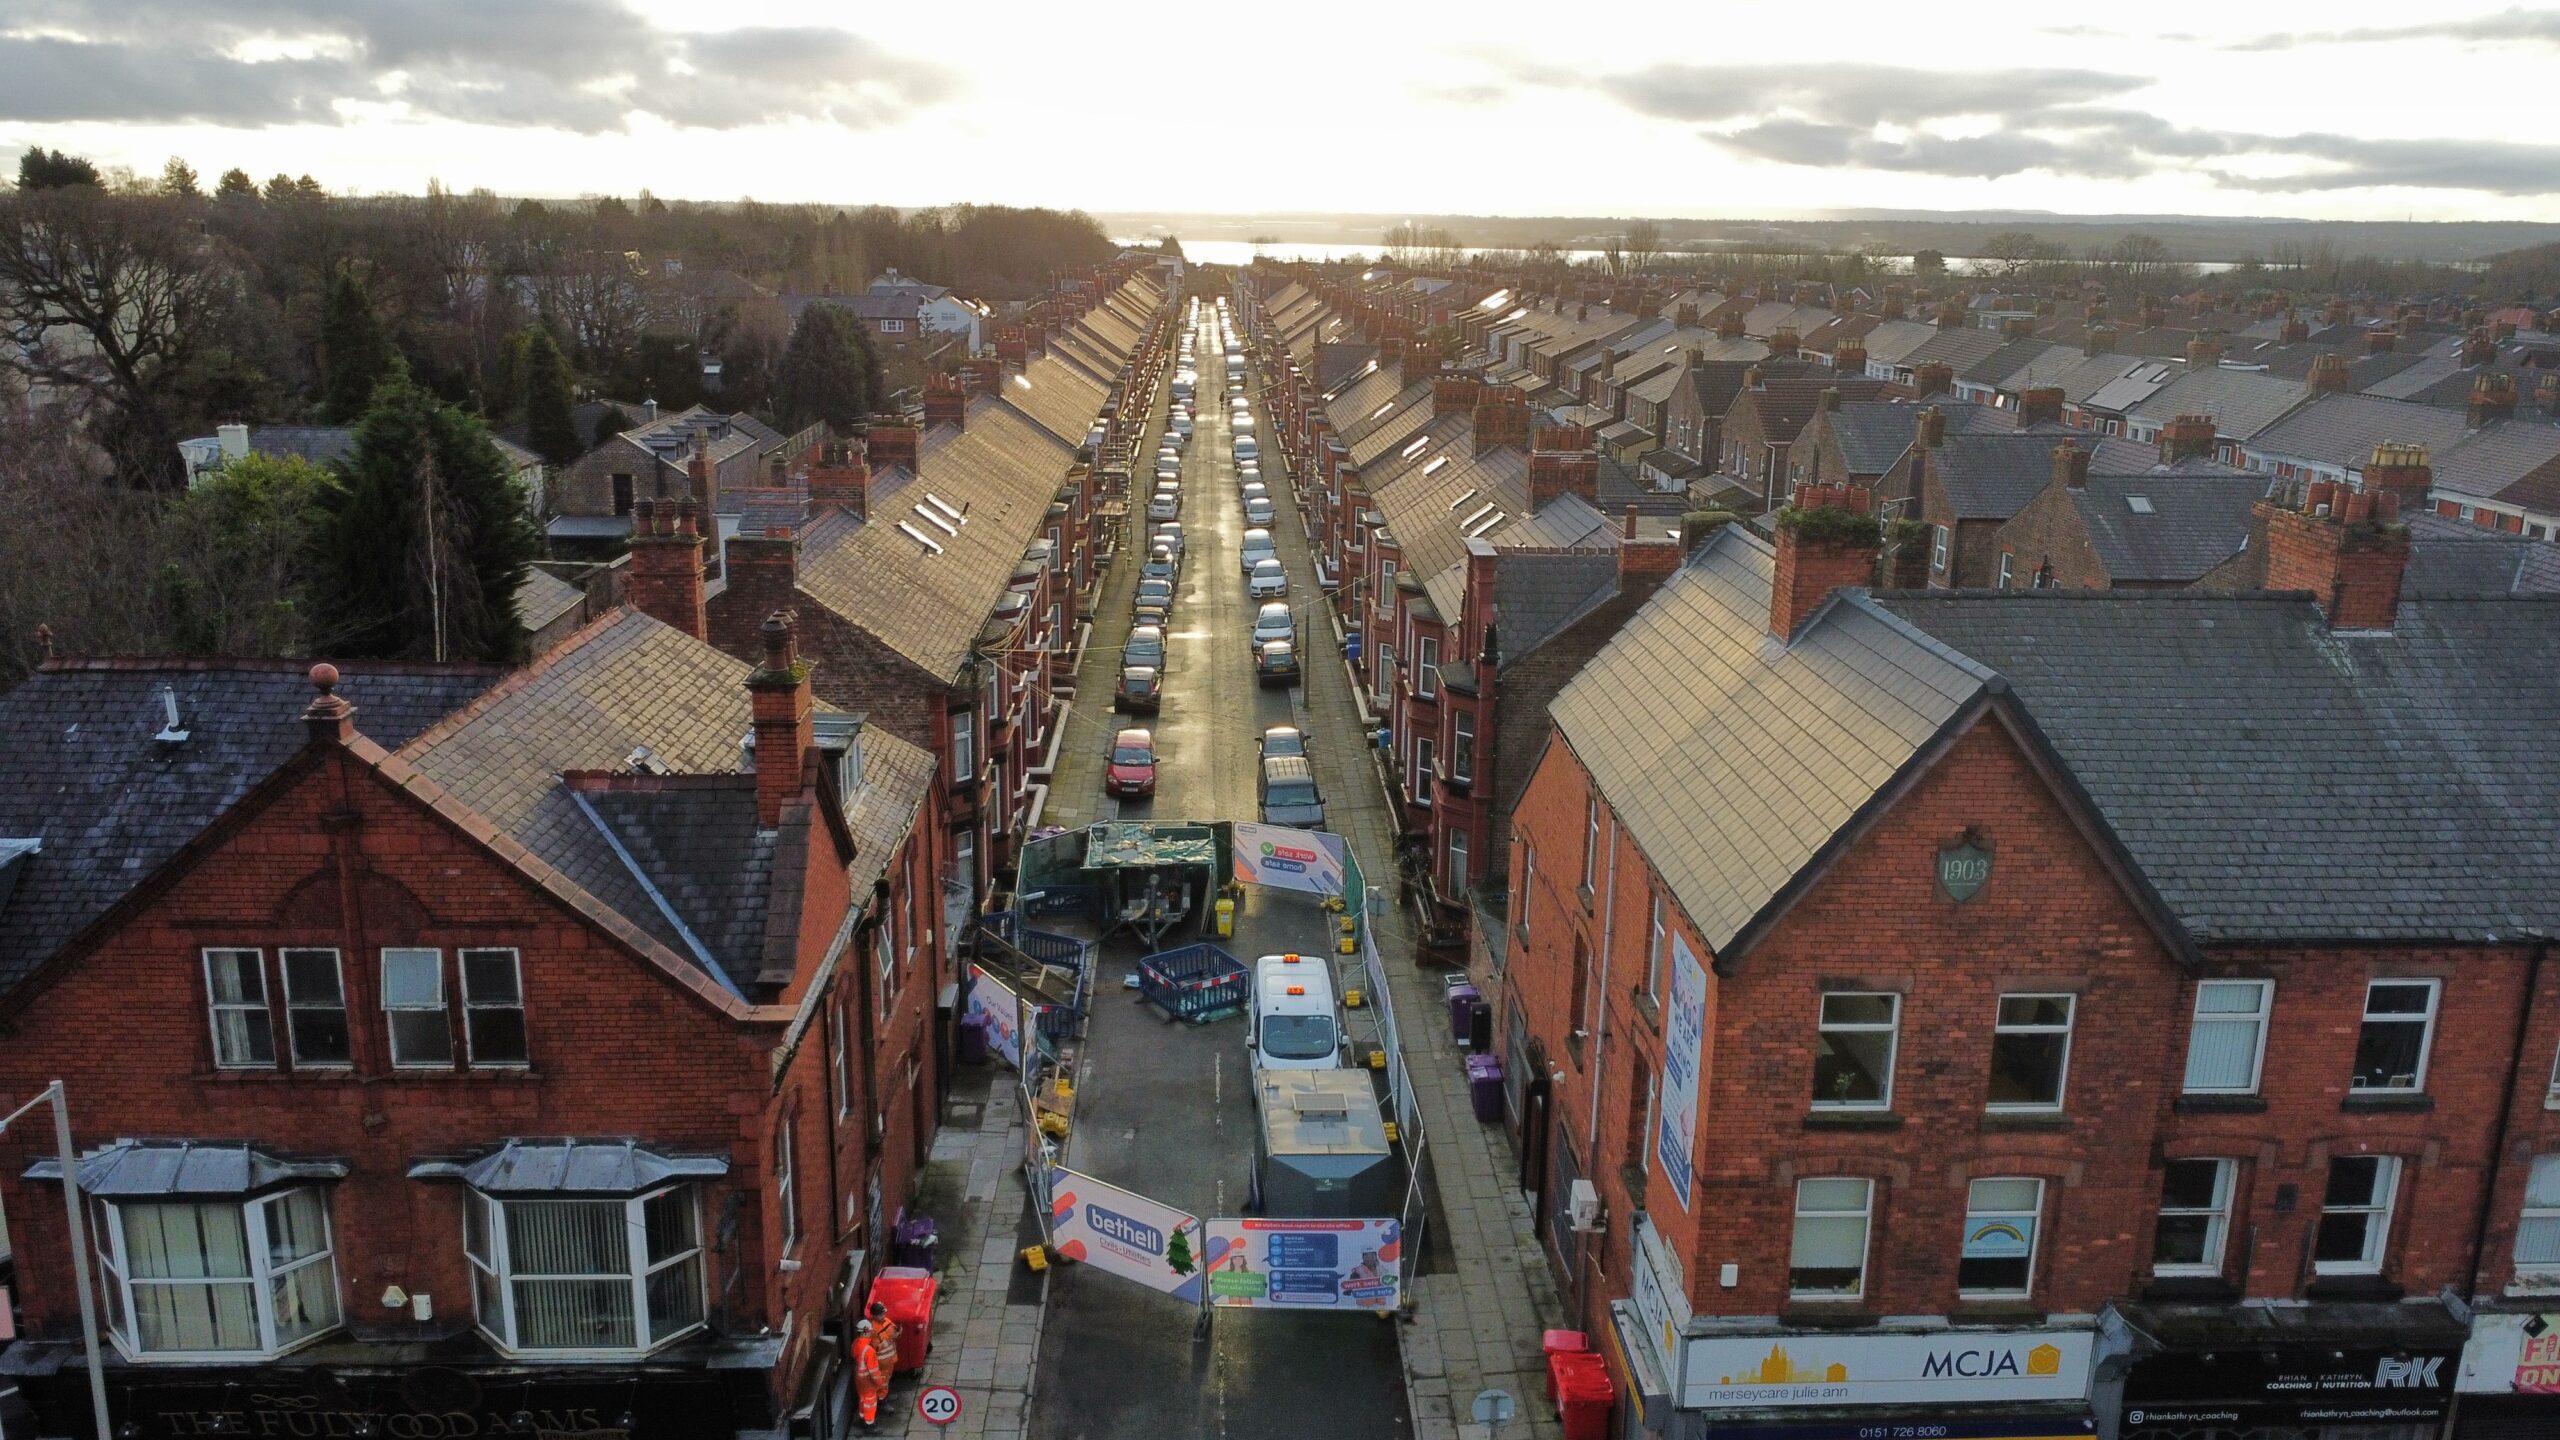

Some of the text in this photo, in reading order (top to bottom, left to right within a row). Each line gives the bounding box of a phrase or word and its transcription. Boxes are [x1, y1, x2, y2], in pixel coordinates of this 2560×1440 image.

[1944, 859, 1988, 881] 1903
[1092, 1208, 1157, 1251] bethell
[1922, 1349, 2019, 1377] MCJA
[2374, 1357, 2445, 1388] RK
[1709, 1385, 1849, 1402] merseycare julie ann
[2266, 1382, 2313, 1390] COACHING
[2322, 1381, 2371, 1389] NUTRITION
[925, 1397, 956, 1414] 20
[1860, 1426, 1947, 1438] 0151 726 8060
